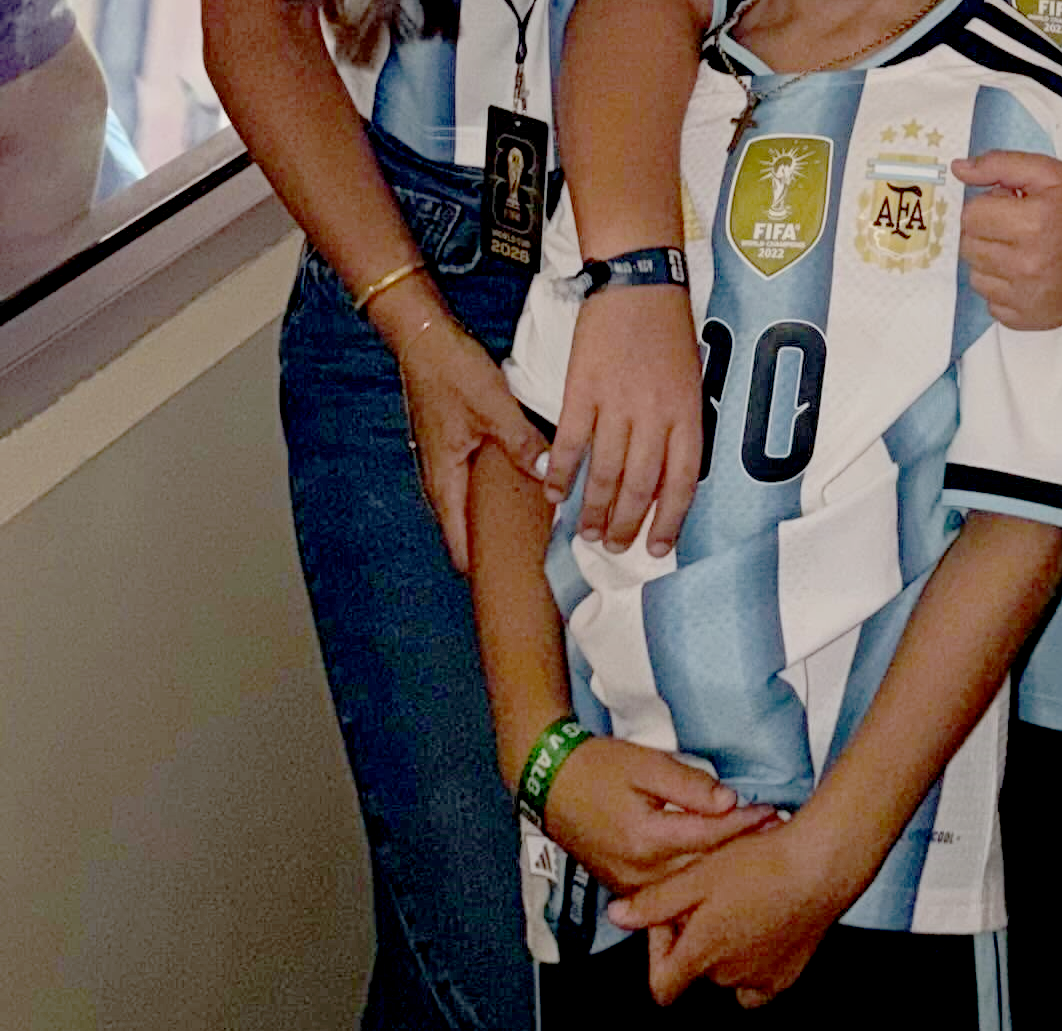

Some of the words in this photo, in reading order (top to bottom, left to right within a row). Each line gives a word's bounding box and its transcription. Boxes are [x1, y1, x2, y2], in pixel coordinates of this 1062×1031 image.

[873, 182, 926, 239] AFA
[753, 222, 797, 241] FIFA
[757, 247, 785, 259] 2022
[697, 317, 828, 485] 10
